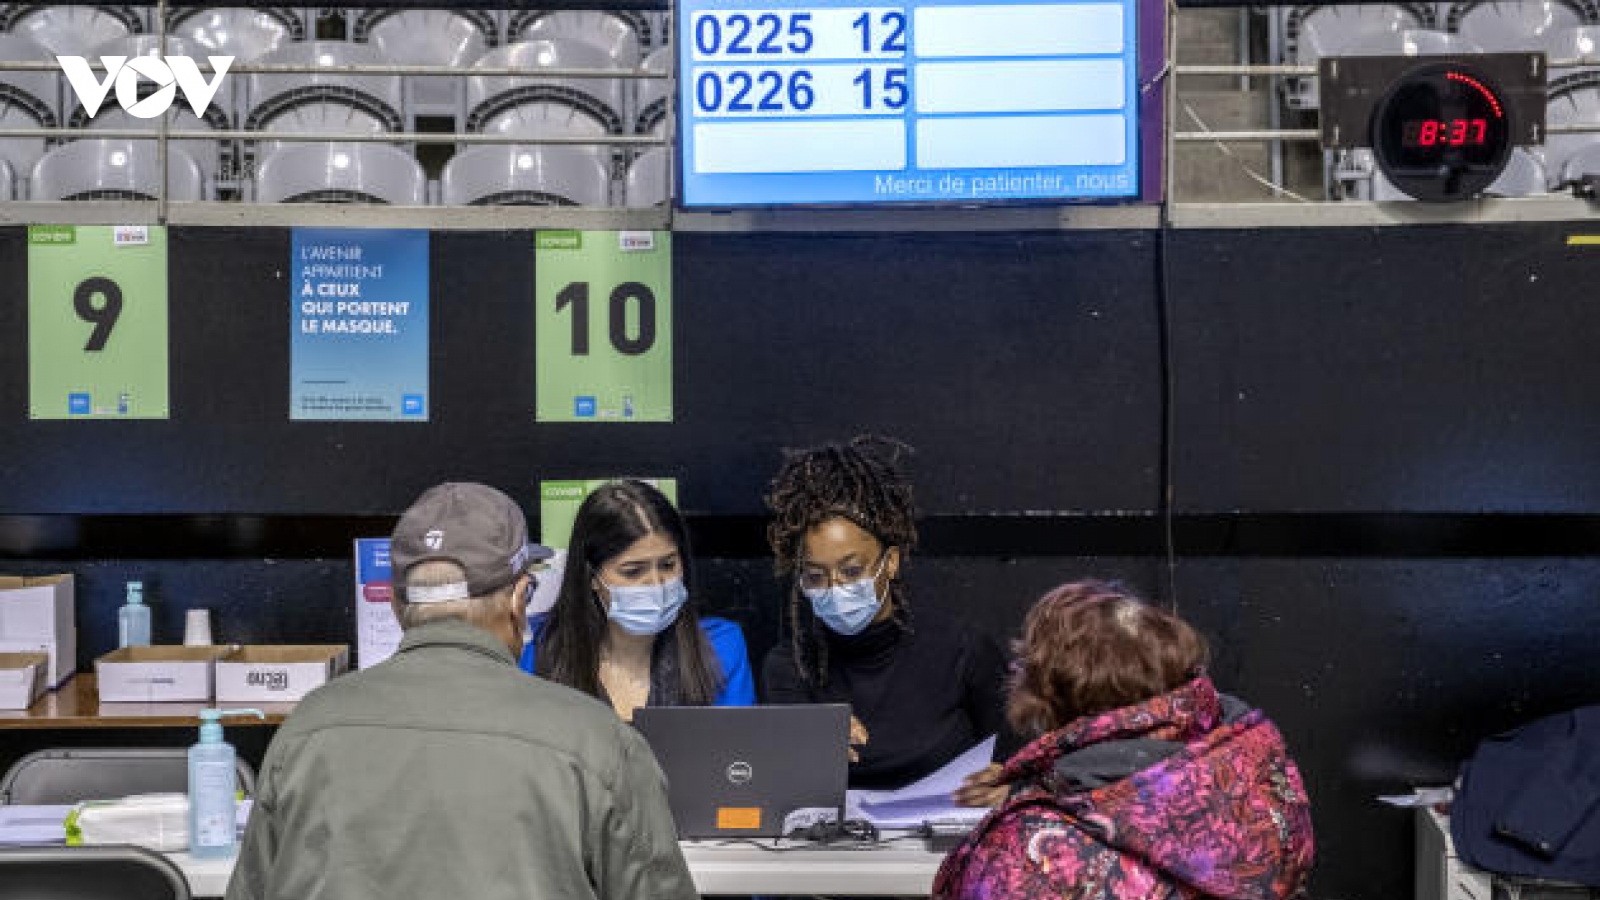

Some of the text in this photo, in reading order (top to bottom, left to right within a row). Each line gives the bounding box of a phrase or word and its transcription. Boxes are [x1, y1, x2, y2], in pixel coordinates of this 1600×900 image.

[695, 11, 908, 55] 0225 12
[696, 67, 910, 112] 0226 15
[1420, 119, 1487, 146] 8:37
[875, 174, 931, 195] Merci
[939, 174, 965, 193] de
[1075, 173, 1130, 191] nous
[317, 283, 360, 297] CEUX
[73, 276, 123, 352] 9
[301, 301, 410, 316] QUI PORTENT
[554, 281, 657, 356] 10
[301, 319, 397, 336] LE MASQUE.
